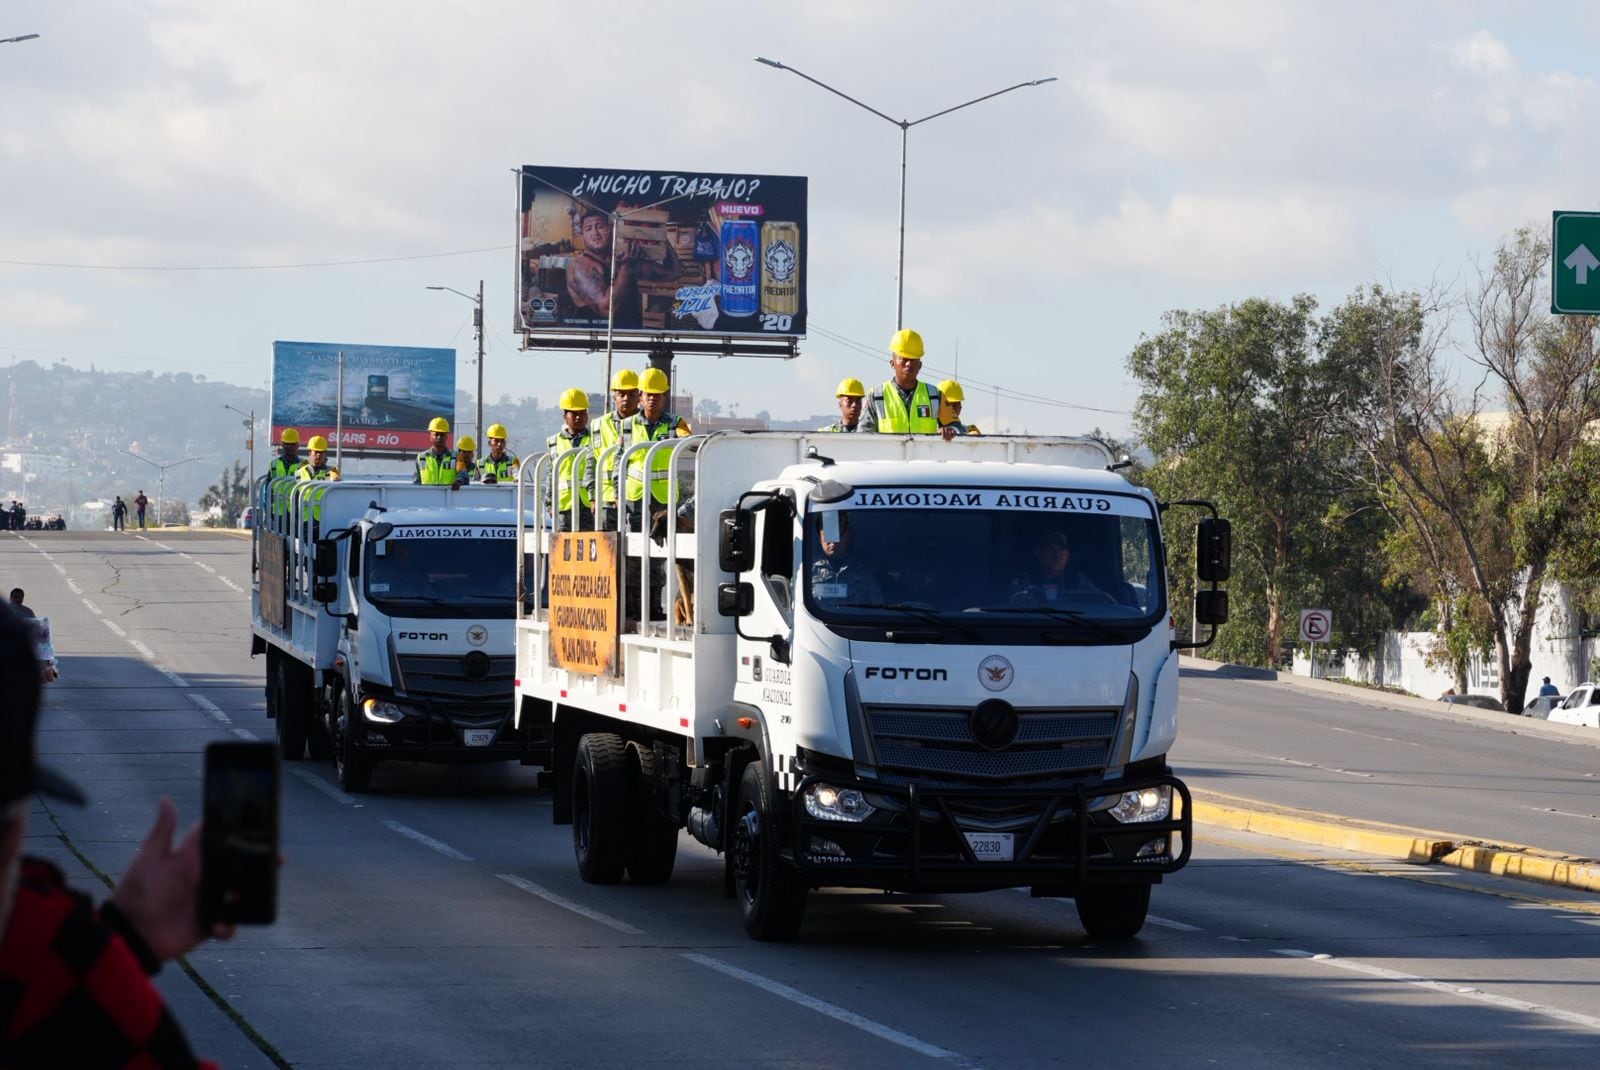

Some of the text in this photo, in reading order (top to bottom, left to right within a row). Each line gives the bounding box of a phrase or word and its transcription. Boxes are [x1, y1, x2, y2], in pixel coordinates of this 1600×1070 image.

[572, 173, 760, 202] ¿MUCHO TRABAJO?
[721, 205, 759, 214] NUEVO
[675, 297, 712, 318] AZUL
[328, 431, 366, 444] SARS
[377, 433, 399, 446] RÍO
[1309, 617, 1322, 635] E
[398, 631, 448, 641] FOTON
[864, 667, 948, 682] FOTON
[973, 841, 1001, 853] 22830
